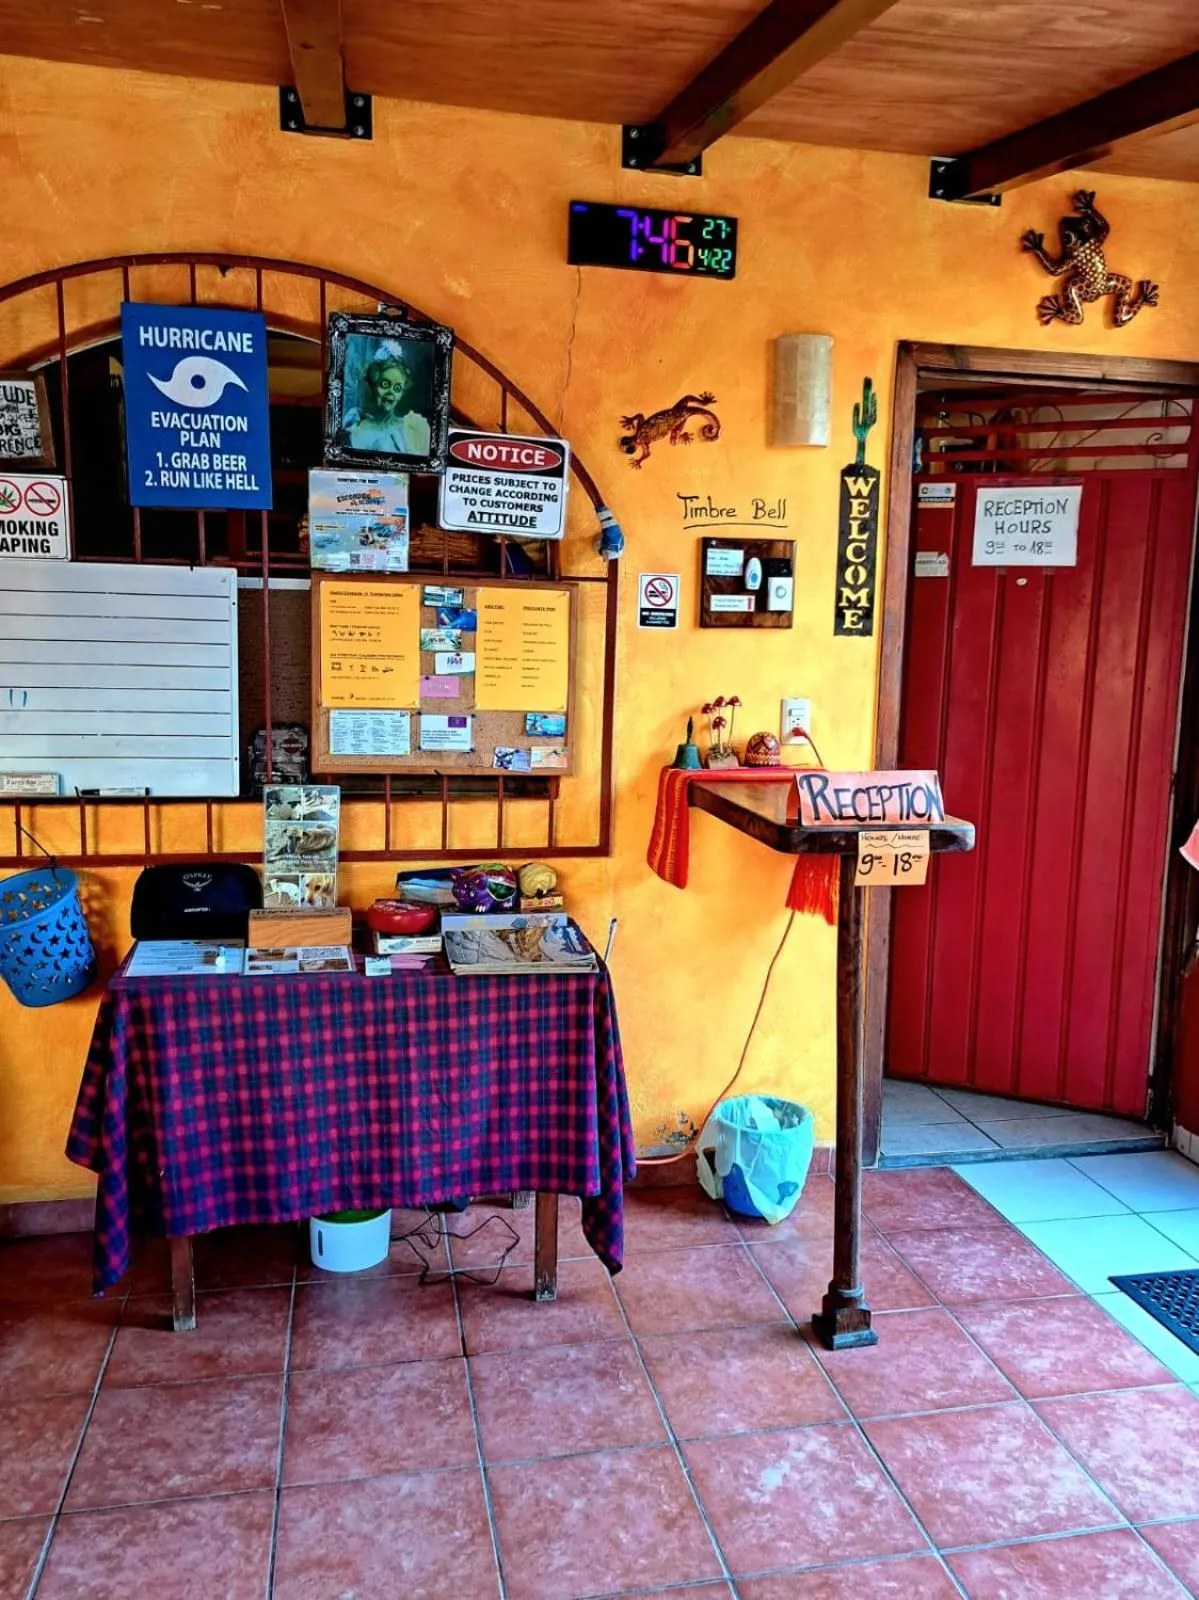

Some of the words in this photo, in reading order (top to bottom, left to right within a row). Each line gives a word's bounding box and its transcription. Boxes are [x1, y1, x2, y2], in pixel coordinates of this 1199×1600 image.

[616, 210, 695, 270] 7:46
[698, 248, 733, 270] 4/22
[139, 326, 254, 353] HURRICANE
[0, 385, 36, 407] UDE
[151, 412, 249, 434] EVACUATION
[180, 432, 222, 450] PLAN
[156, 452, 169, 468] 1.
[171, 453, 210, 471] GRAB
[213, 455, 248, 472] BEER
[467, 443, 546, 466] NOTICE
[145, 471, 158, 487] 2.
[161, 471, 192, 488] RUN
[193, 472, 222, 489] LIKE
[225, 473, 260, 491] HELL
[451, 473, 492, 486] PRICES
[493, 476, 540, 490] SUBJECT
[542, 481, 557, 492] TO
[448, 484, 493, 497] CHANGE
[495, 489, 559, 503] ACCORDING
[462, 497, 478, 507] TO
[480, 498, 544, 513] CUSTOMERS
[677, 492, 738, 520] Timbre
[752, 498, 787, 520] Bell
[467, 510, 538, 529] ATTITUDE
[995, 520, 1053, 535] HOURS
[838, 476, 877, 630] WELCOME
[798, 773, 945, 822] RECEPTION
